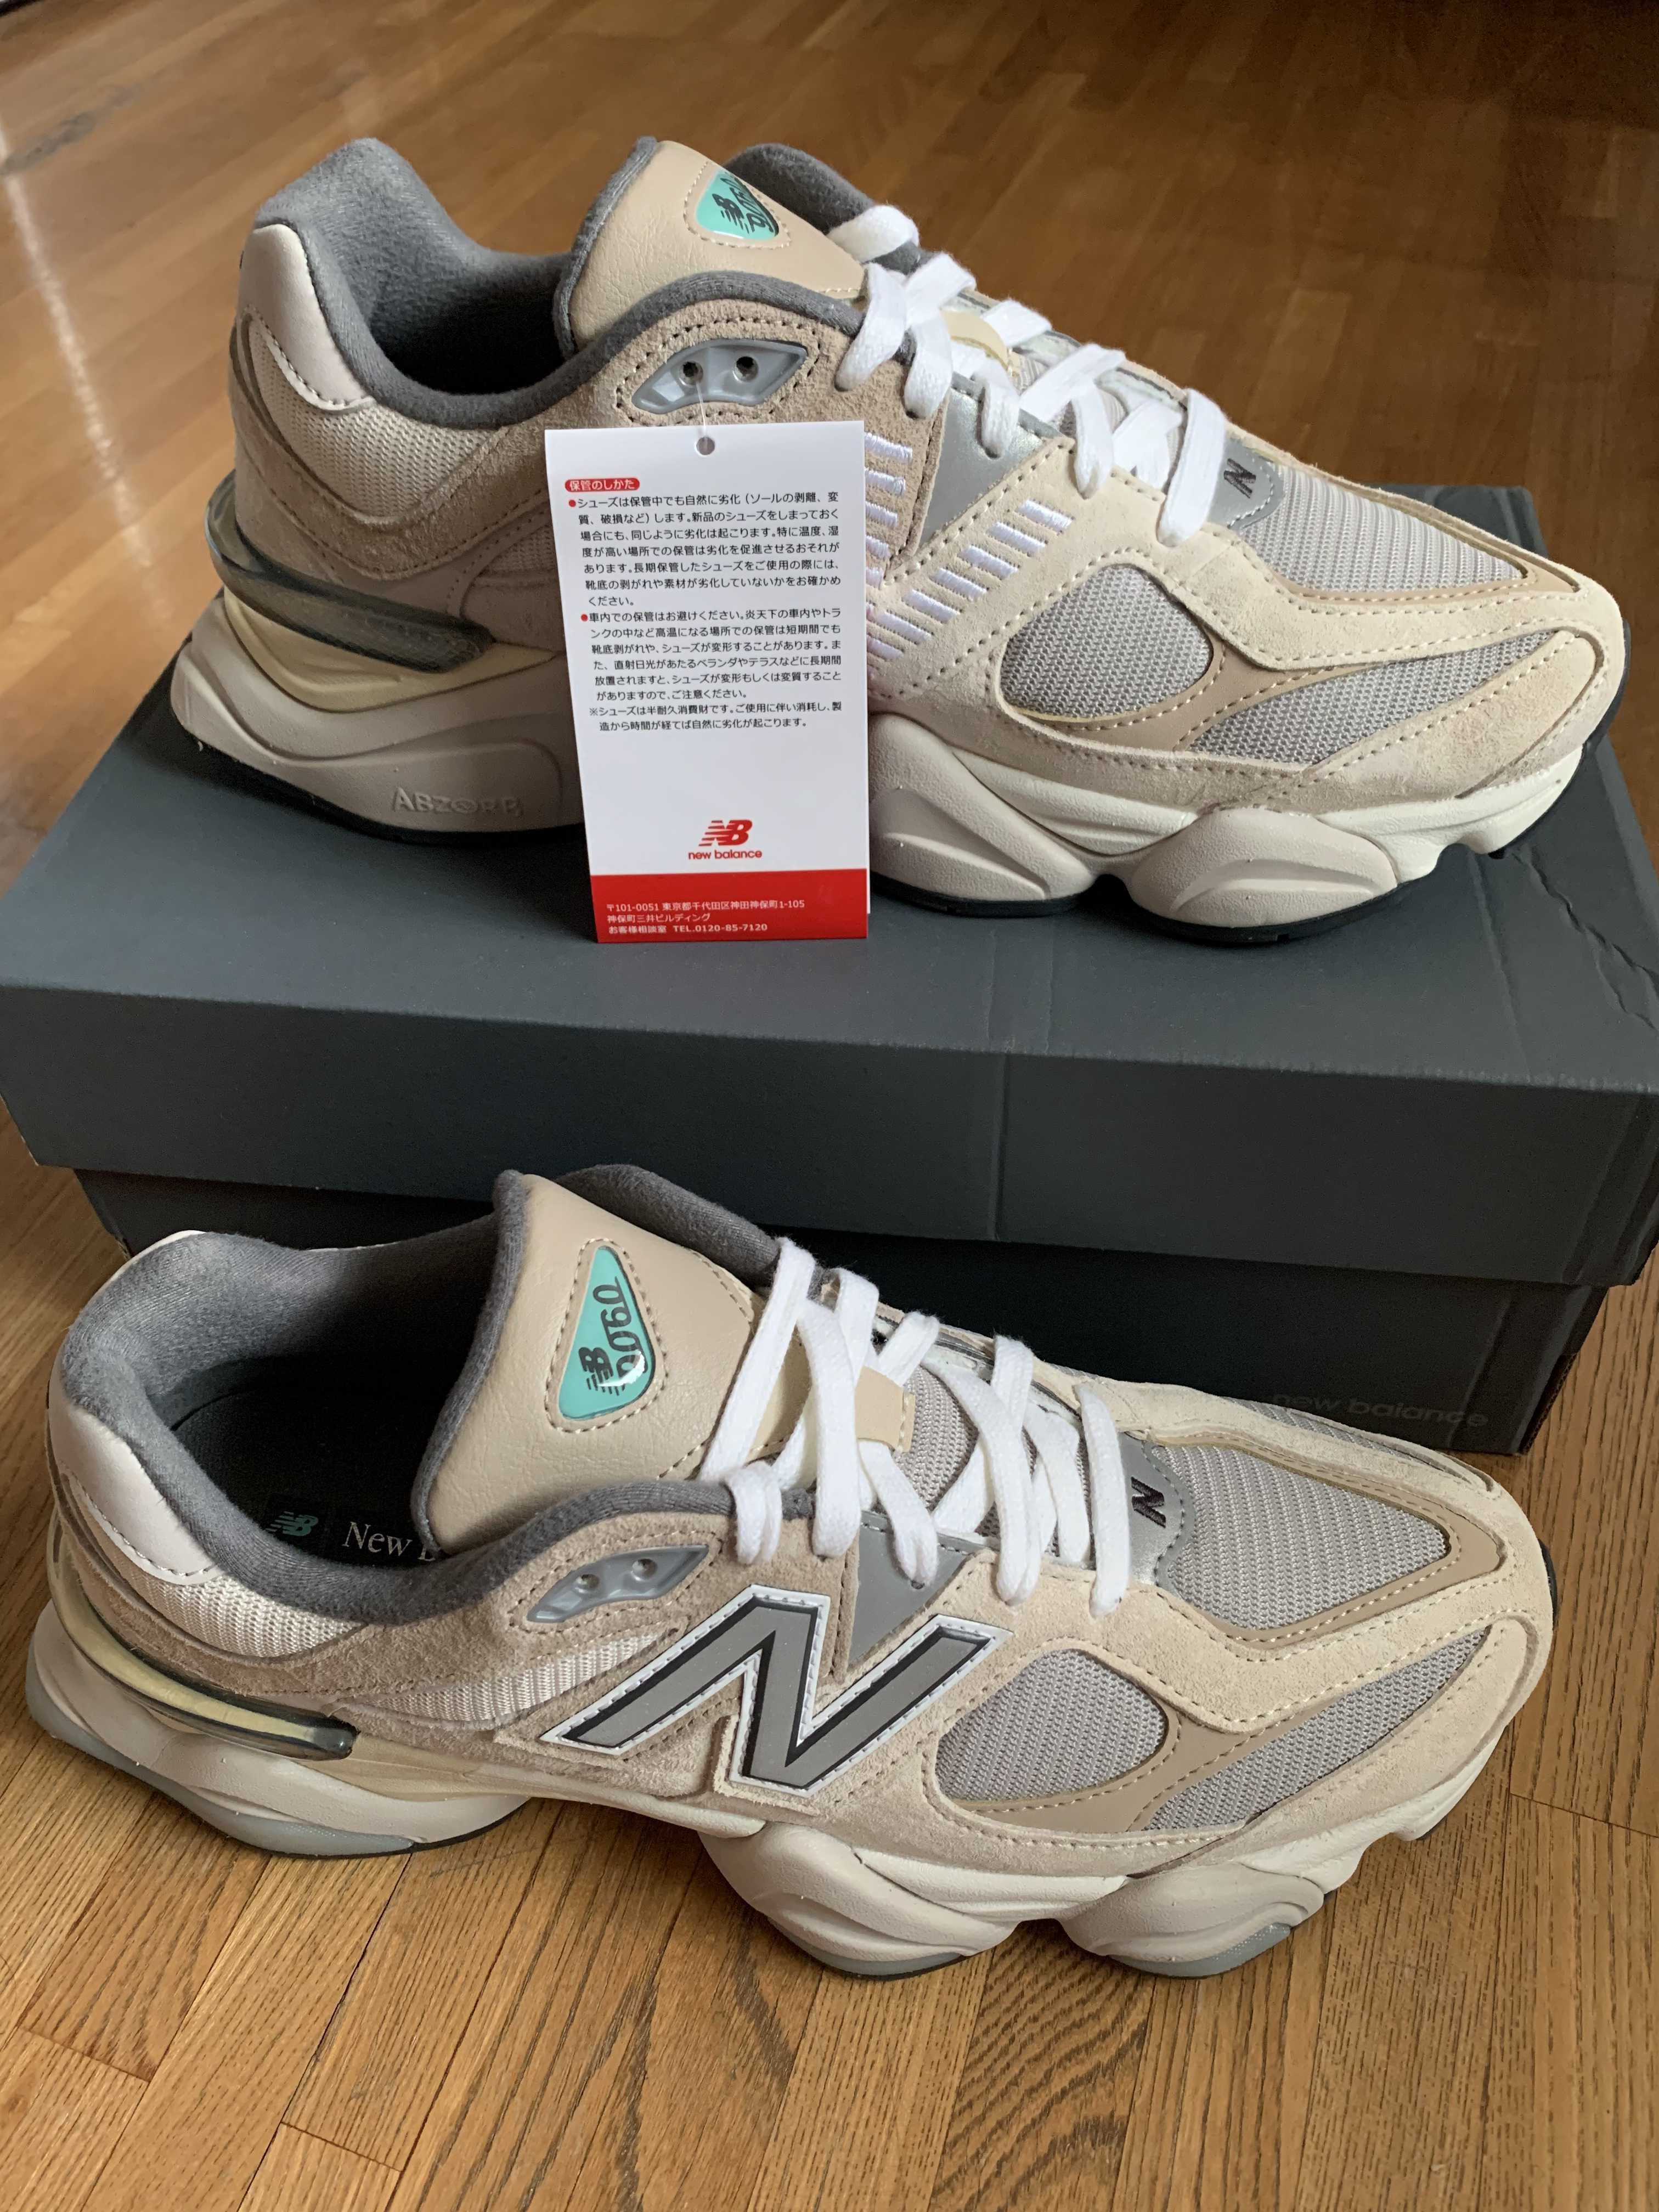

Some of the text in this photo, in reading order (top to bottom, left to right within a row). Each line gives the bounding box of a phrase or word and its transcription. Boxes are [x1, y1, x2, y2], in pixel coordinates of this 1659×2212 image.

[1224, 458, 1256, 499] N
[569, 480, 635, 492] 保管のしかた
[582, 541, 840, 557] 度が高い場所での保管は劣化を促進させるおそれが
[588, 596, 634, 606] ください。
[590, 624, 841, 639] ンクの中など高温になる場所での保管は短期間でも
[596, 689, 747, 701] がありますので、ご注意ください。
[600, 718, 806, 731] 造から時間が経てば自然に劣化が起こります。
[688, 849, 762, 860] new balance
[607, 913, 711, 923] 神保町三井ビルディング
[608, 923, 768, 934] お客様相談室 TEL.0120-85-7120
[1272, 1393, 1489, 1427] new balance
[1131, 1476, 1166, 1528] N
[342, 1521, 413, 1556] New
[540, 1585, 1013, 1797] N
